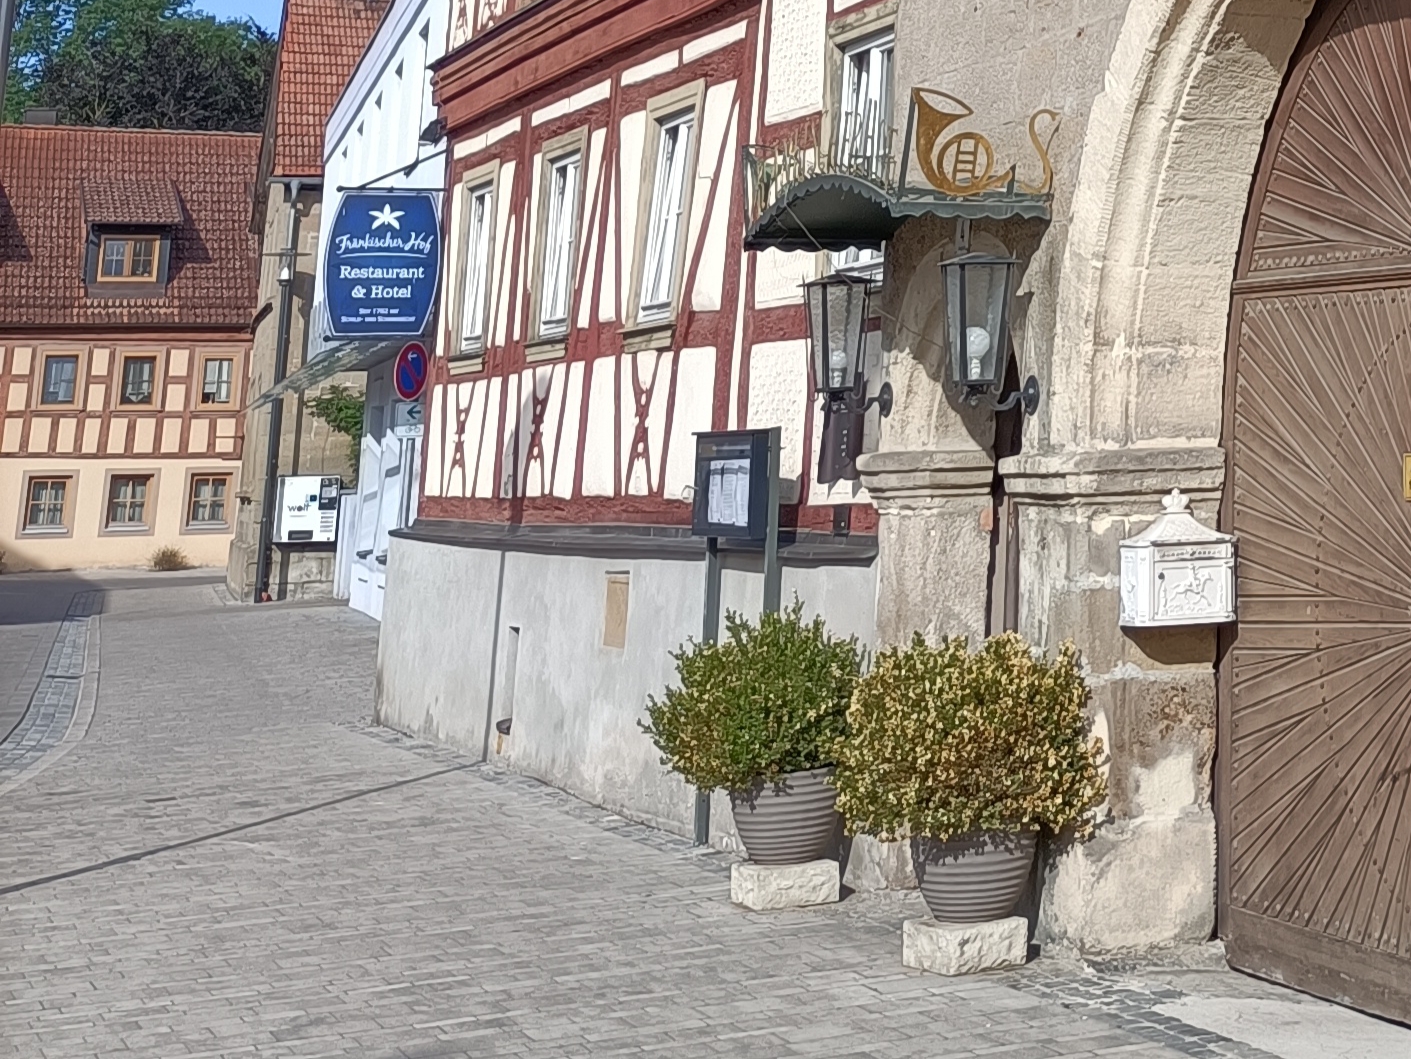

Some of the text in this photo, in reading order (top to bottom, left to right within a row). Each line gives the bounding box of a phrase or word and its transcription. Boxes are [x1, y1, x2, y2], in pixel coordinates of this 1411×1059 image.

[404, 231, 434, 254] Hof
[339, 265, 424, 279] Restaurant
[351, 285, 411, 298] & Hotel
